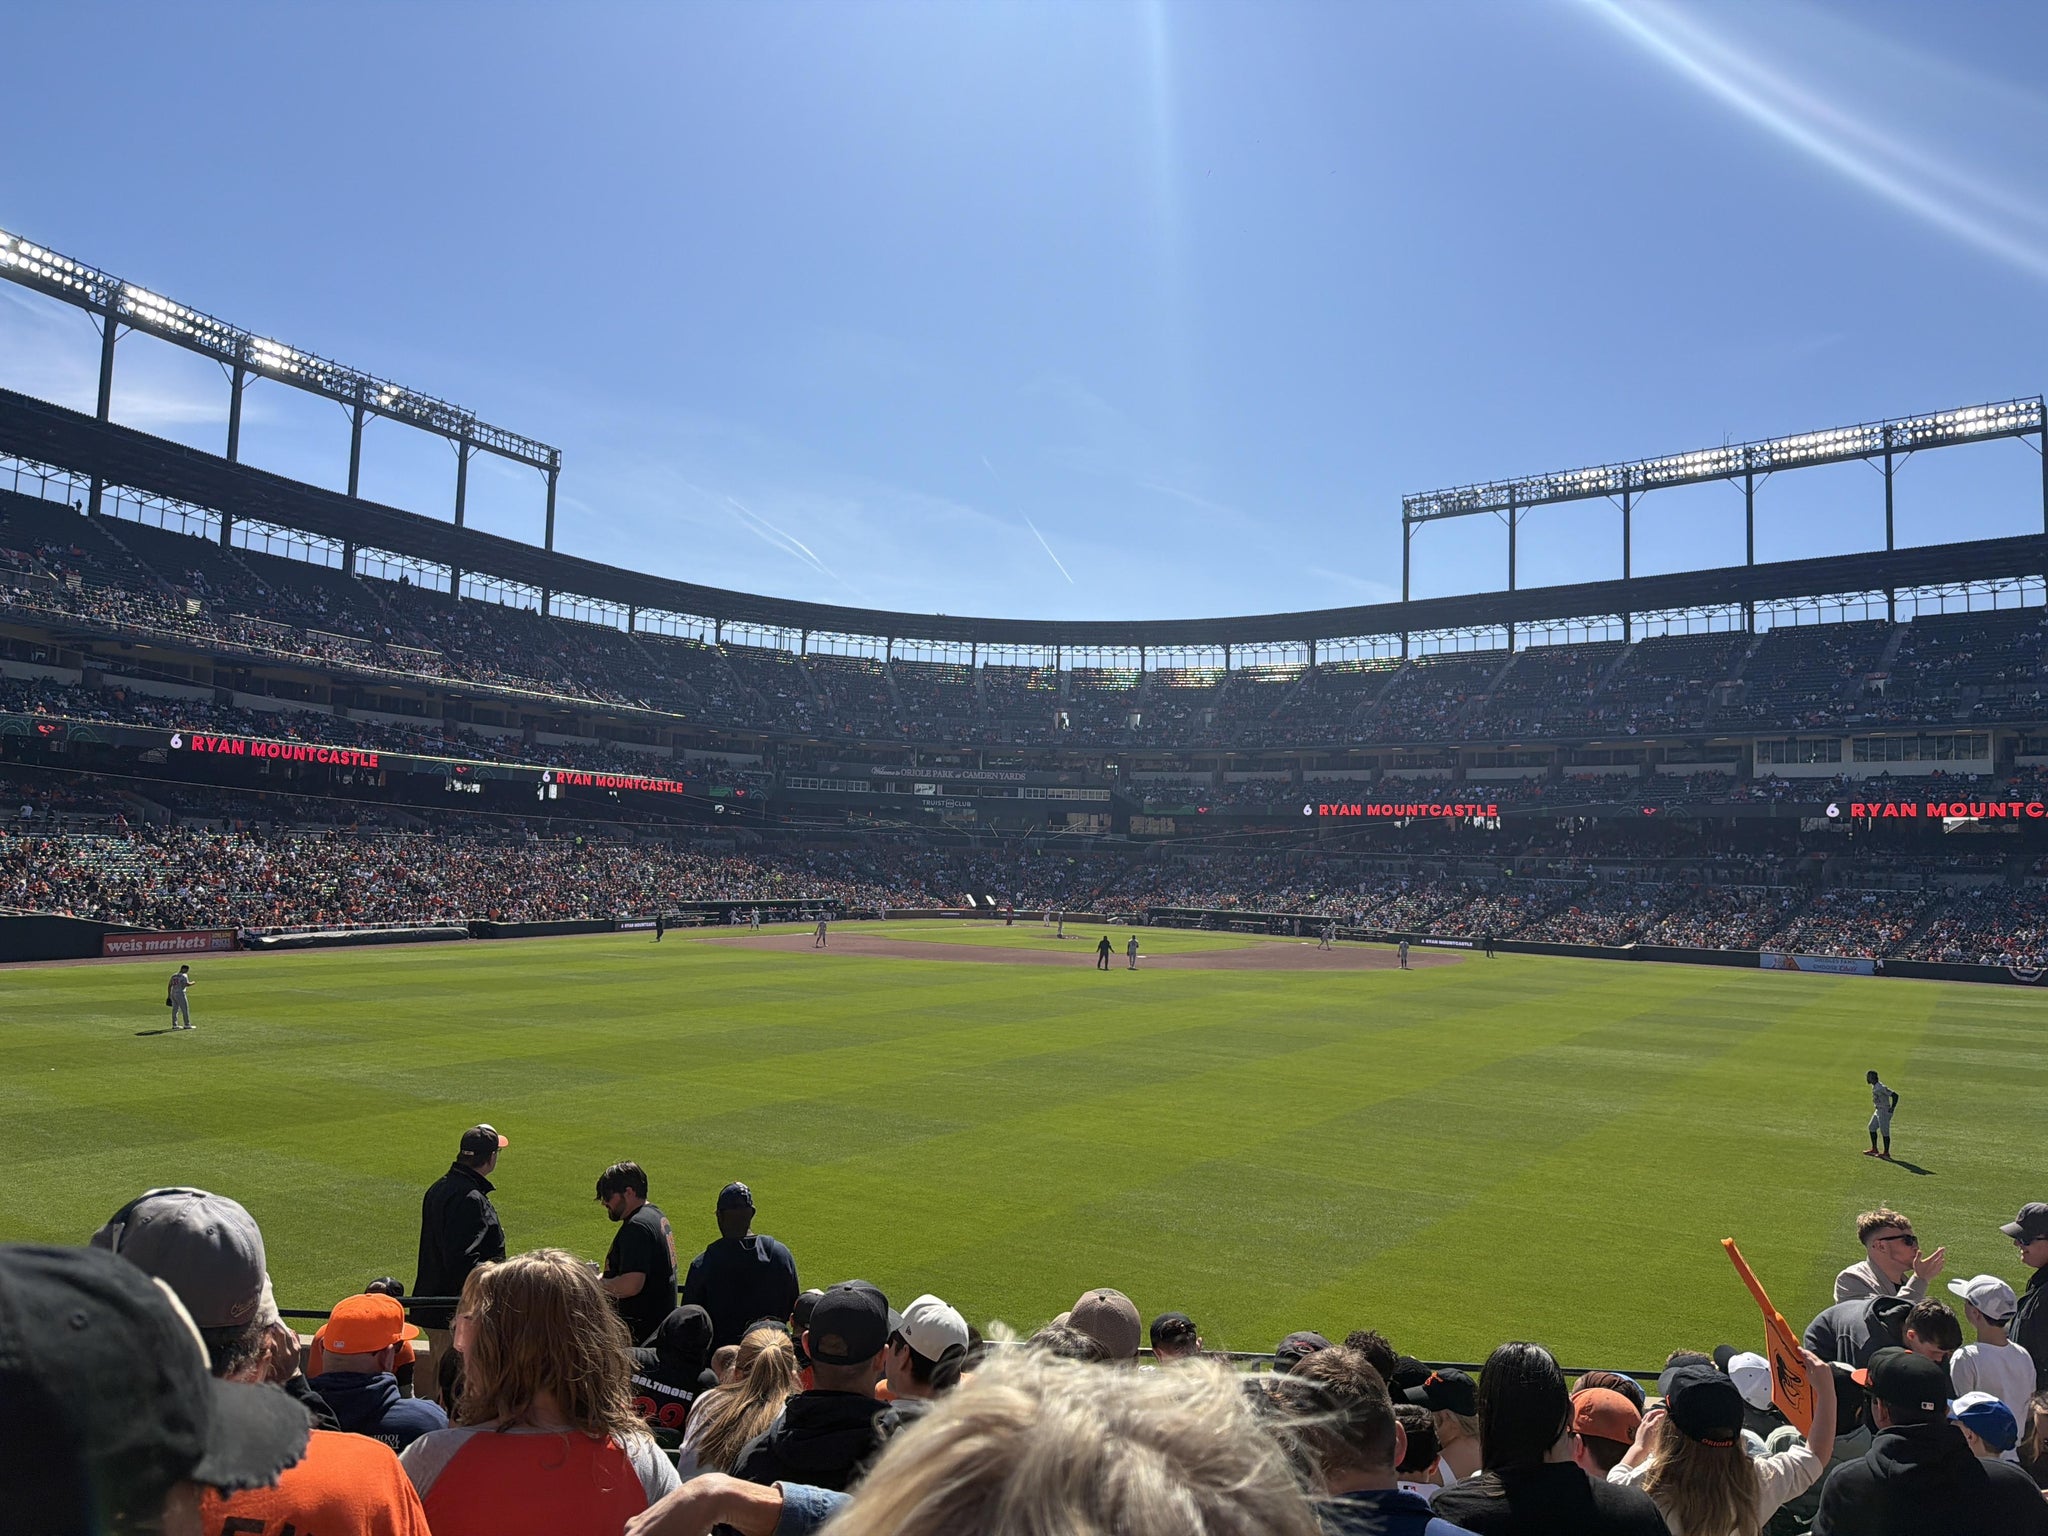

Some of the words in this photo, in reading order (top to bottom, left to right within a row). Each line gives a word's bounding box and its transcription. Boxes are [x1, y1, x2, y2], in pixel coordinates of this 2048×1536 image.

[170, 734, 183, 749] 6
[192, 735, 245, 755] RYAN
[251, 742, 379, 768] MOUNTCASTLE
[542, 770, 551, 783] 6
[556, 772, 592, 786] RYAN
[596, 776, 684, 793] MOUNTCASTLE
[901, 768, 931, 778] ORIOLE
[933, 769, 953, 778] PARK
[962, 770, 998, 780] CAMDEN
[999, 772, 1026, 781] YARDS
[1303, 804, 1312, 816] 6
[1319, 804, 1361, 816] RYAN
[1367, 804, 1498, 817] MOUNTCASTLE
[1826, 803, 1840, 818] 6
[1851, 803, 1917, 817] RYAN
[1926, 802, 2048, 818] MOUNTC
[107, 938, 143, 952] weis
[145, 936, 206, 950] markets
[630, 1374, 694, 1402] BALTIMORE
